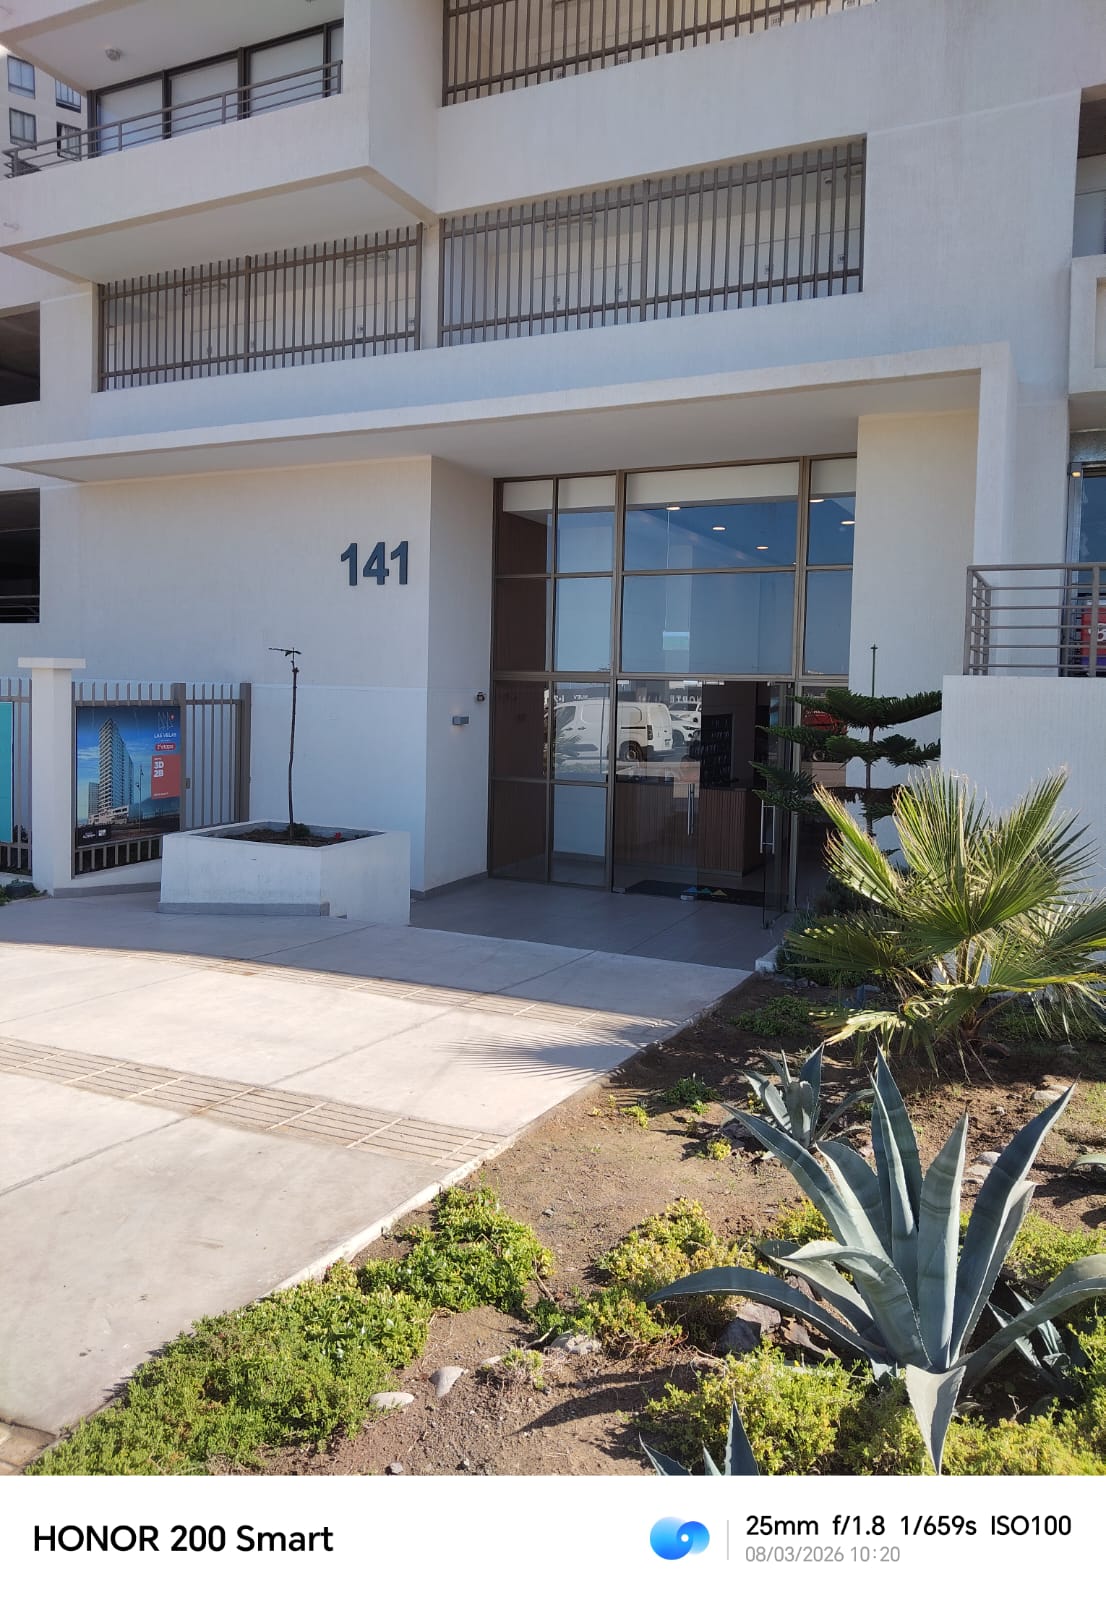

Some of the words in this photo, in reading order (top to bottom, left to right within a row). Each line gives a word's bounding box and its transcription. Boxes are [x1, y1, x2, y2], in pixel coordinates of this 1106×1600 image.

[341, 541, 409, 586] 141
[153, 761, 164, 769] 3D
[153, 769, 164, 778] 2B
